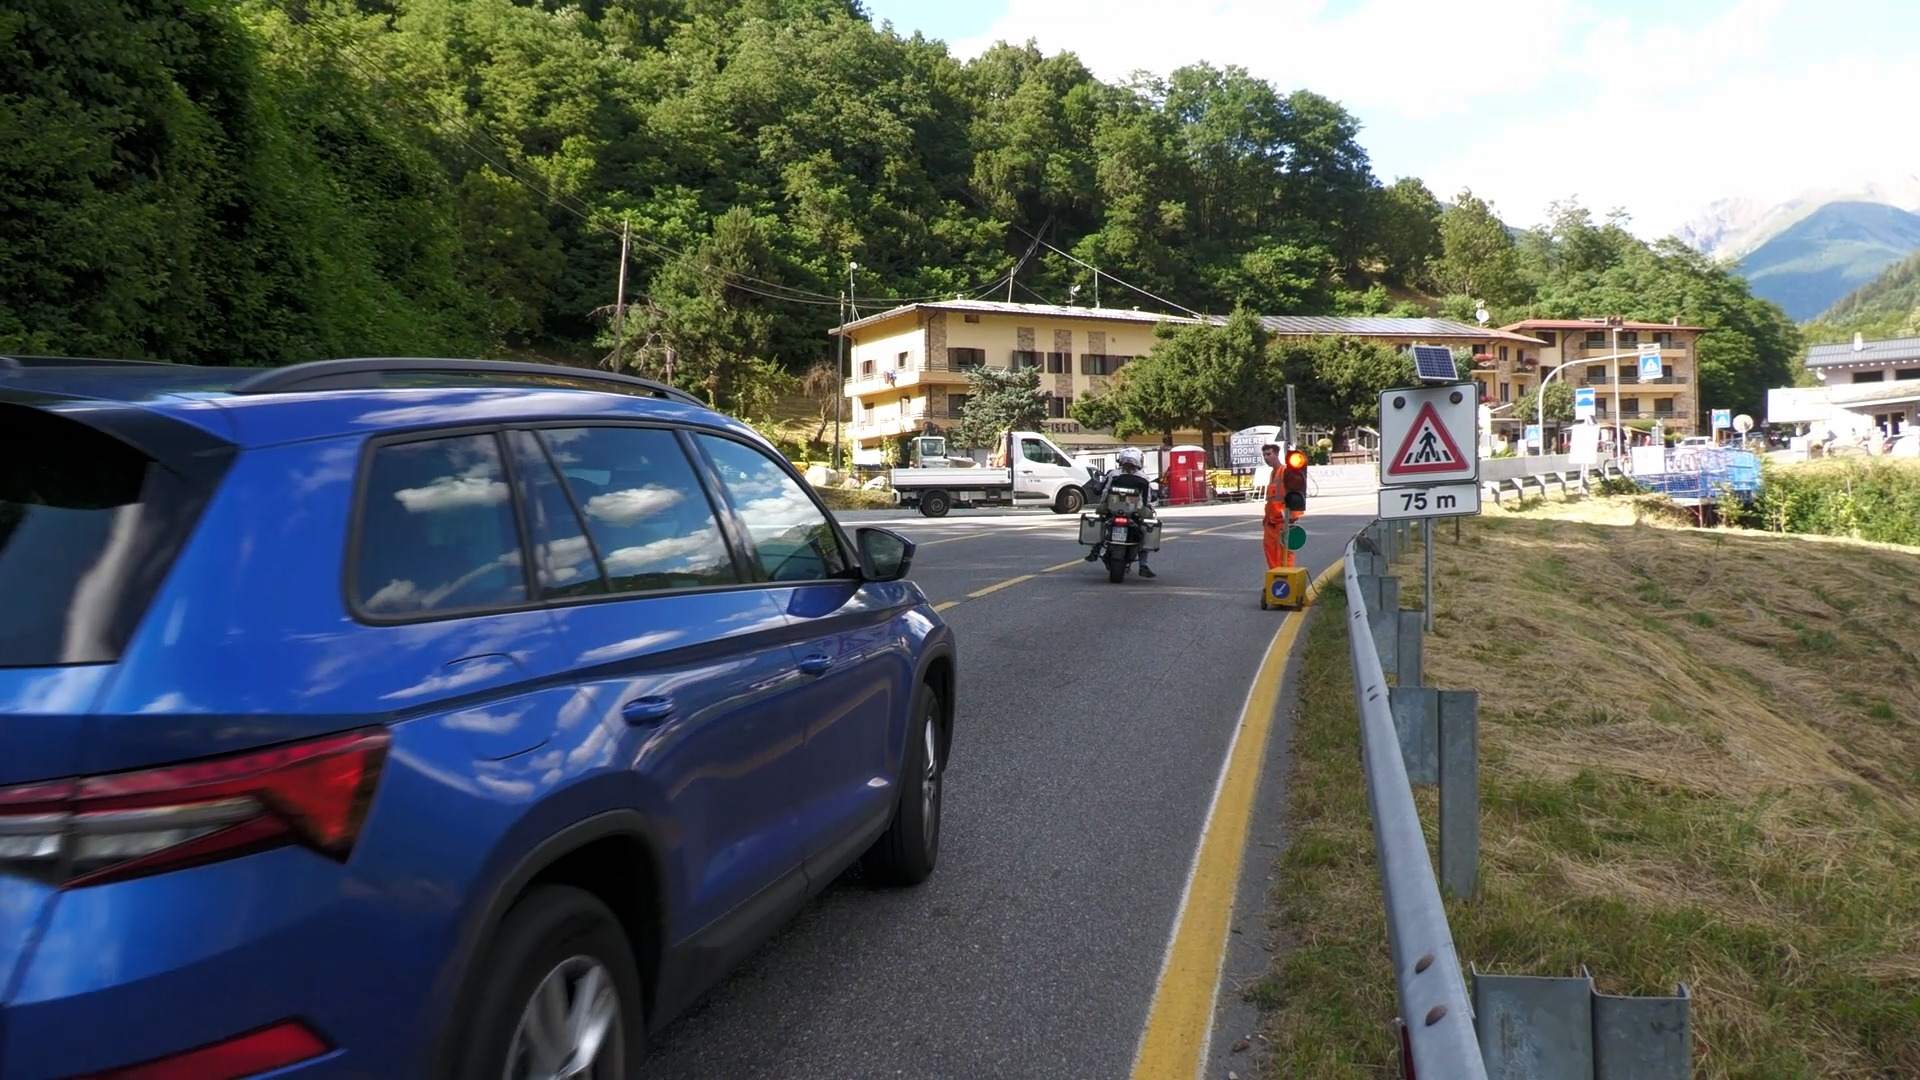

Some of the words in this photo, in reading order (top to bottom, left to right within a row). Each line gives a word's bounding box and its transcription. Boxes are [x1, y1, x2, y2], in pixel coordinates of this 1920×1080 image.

[1232, 437, 1263, 445] CAMERE
[1232, 447, 1255, 455] ROOM
[1232, 457, 1262, 465] ZIMMER
[1400, 492, 1427, 511] 75
[1436, 494, 1456, 509] m
